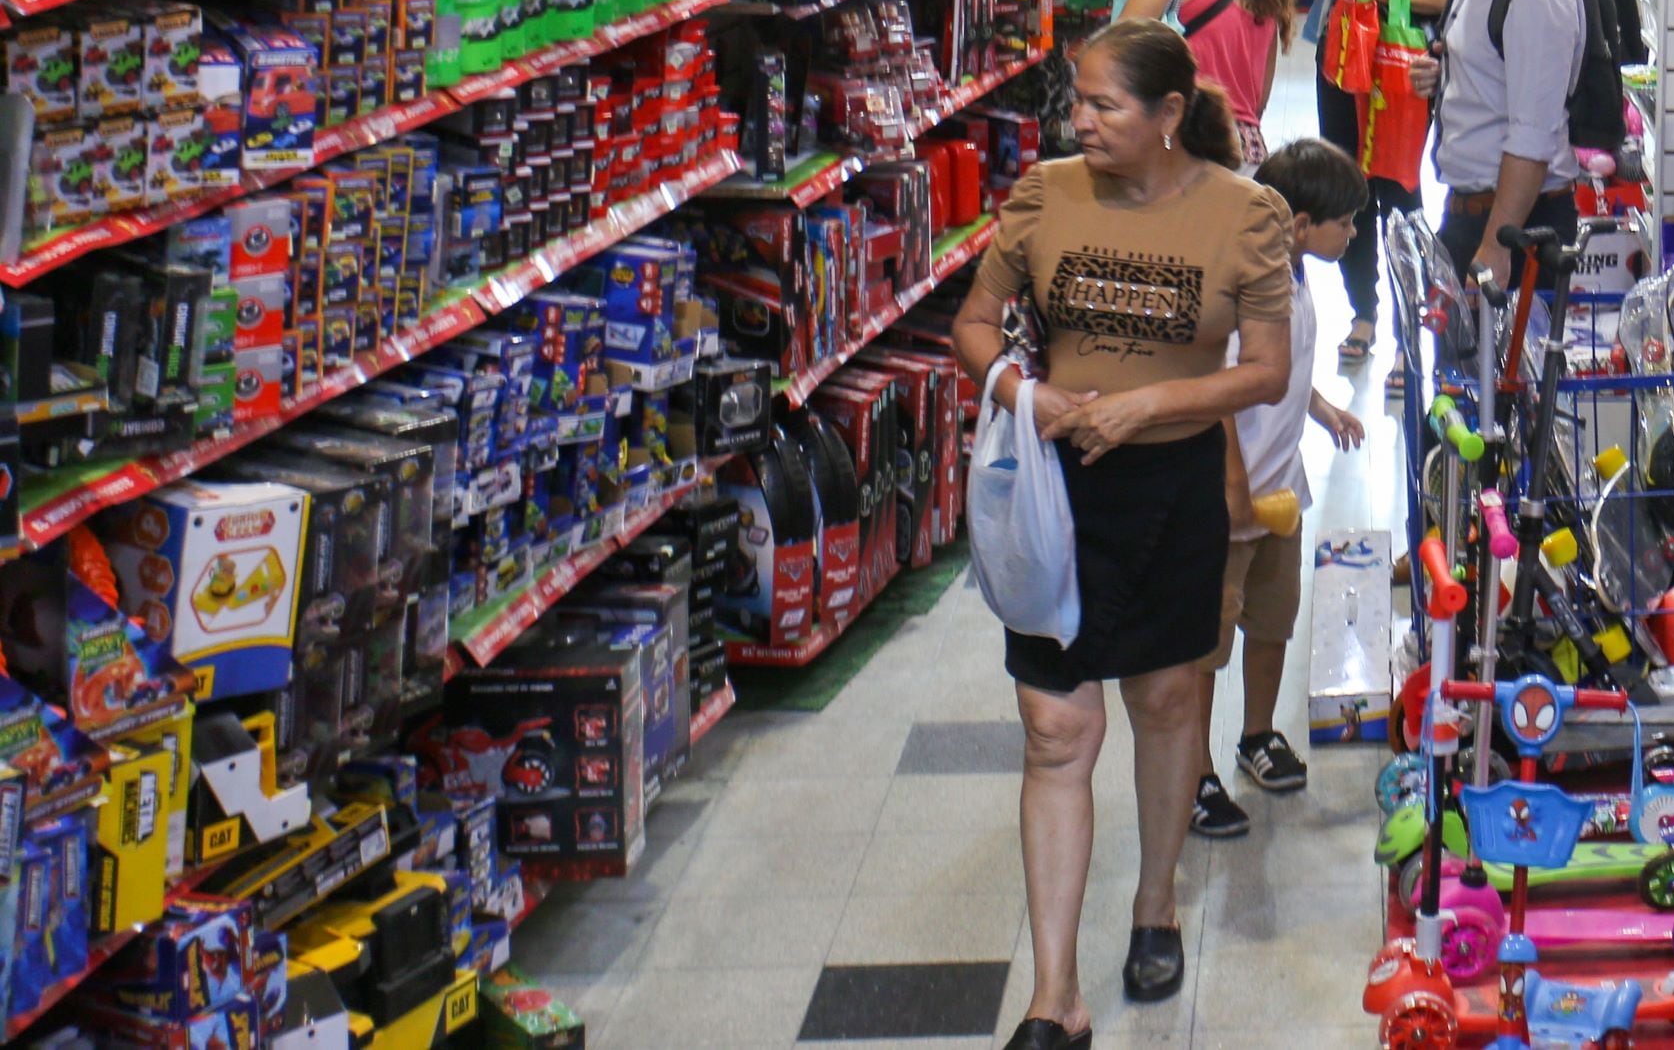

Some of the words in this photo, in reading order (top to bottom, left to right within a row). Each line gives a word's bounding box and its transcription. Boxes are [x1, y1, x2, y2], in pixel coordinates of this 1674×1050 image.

[1069, 281, 1176, 311] HAPPEN
[137, 771, 157, 843] METAL
[208, 827, 233, 850] CAT
[451, 993, 471, 1020] CAT
